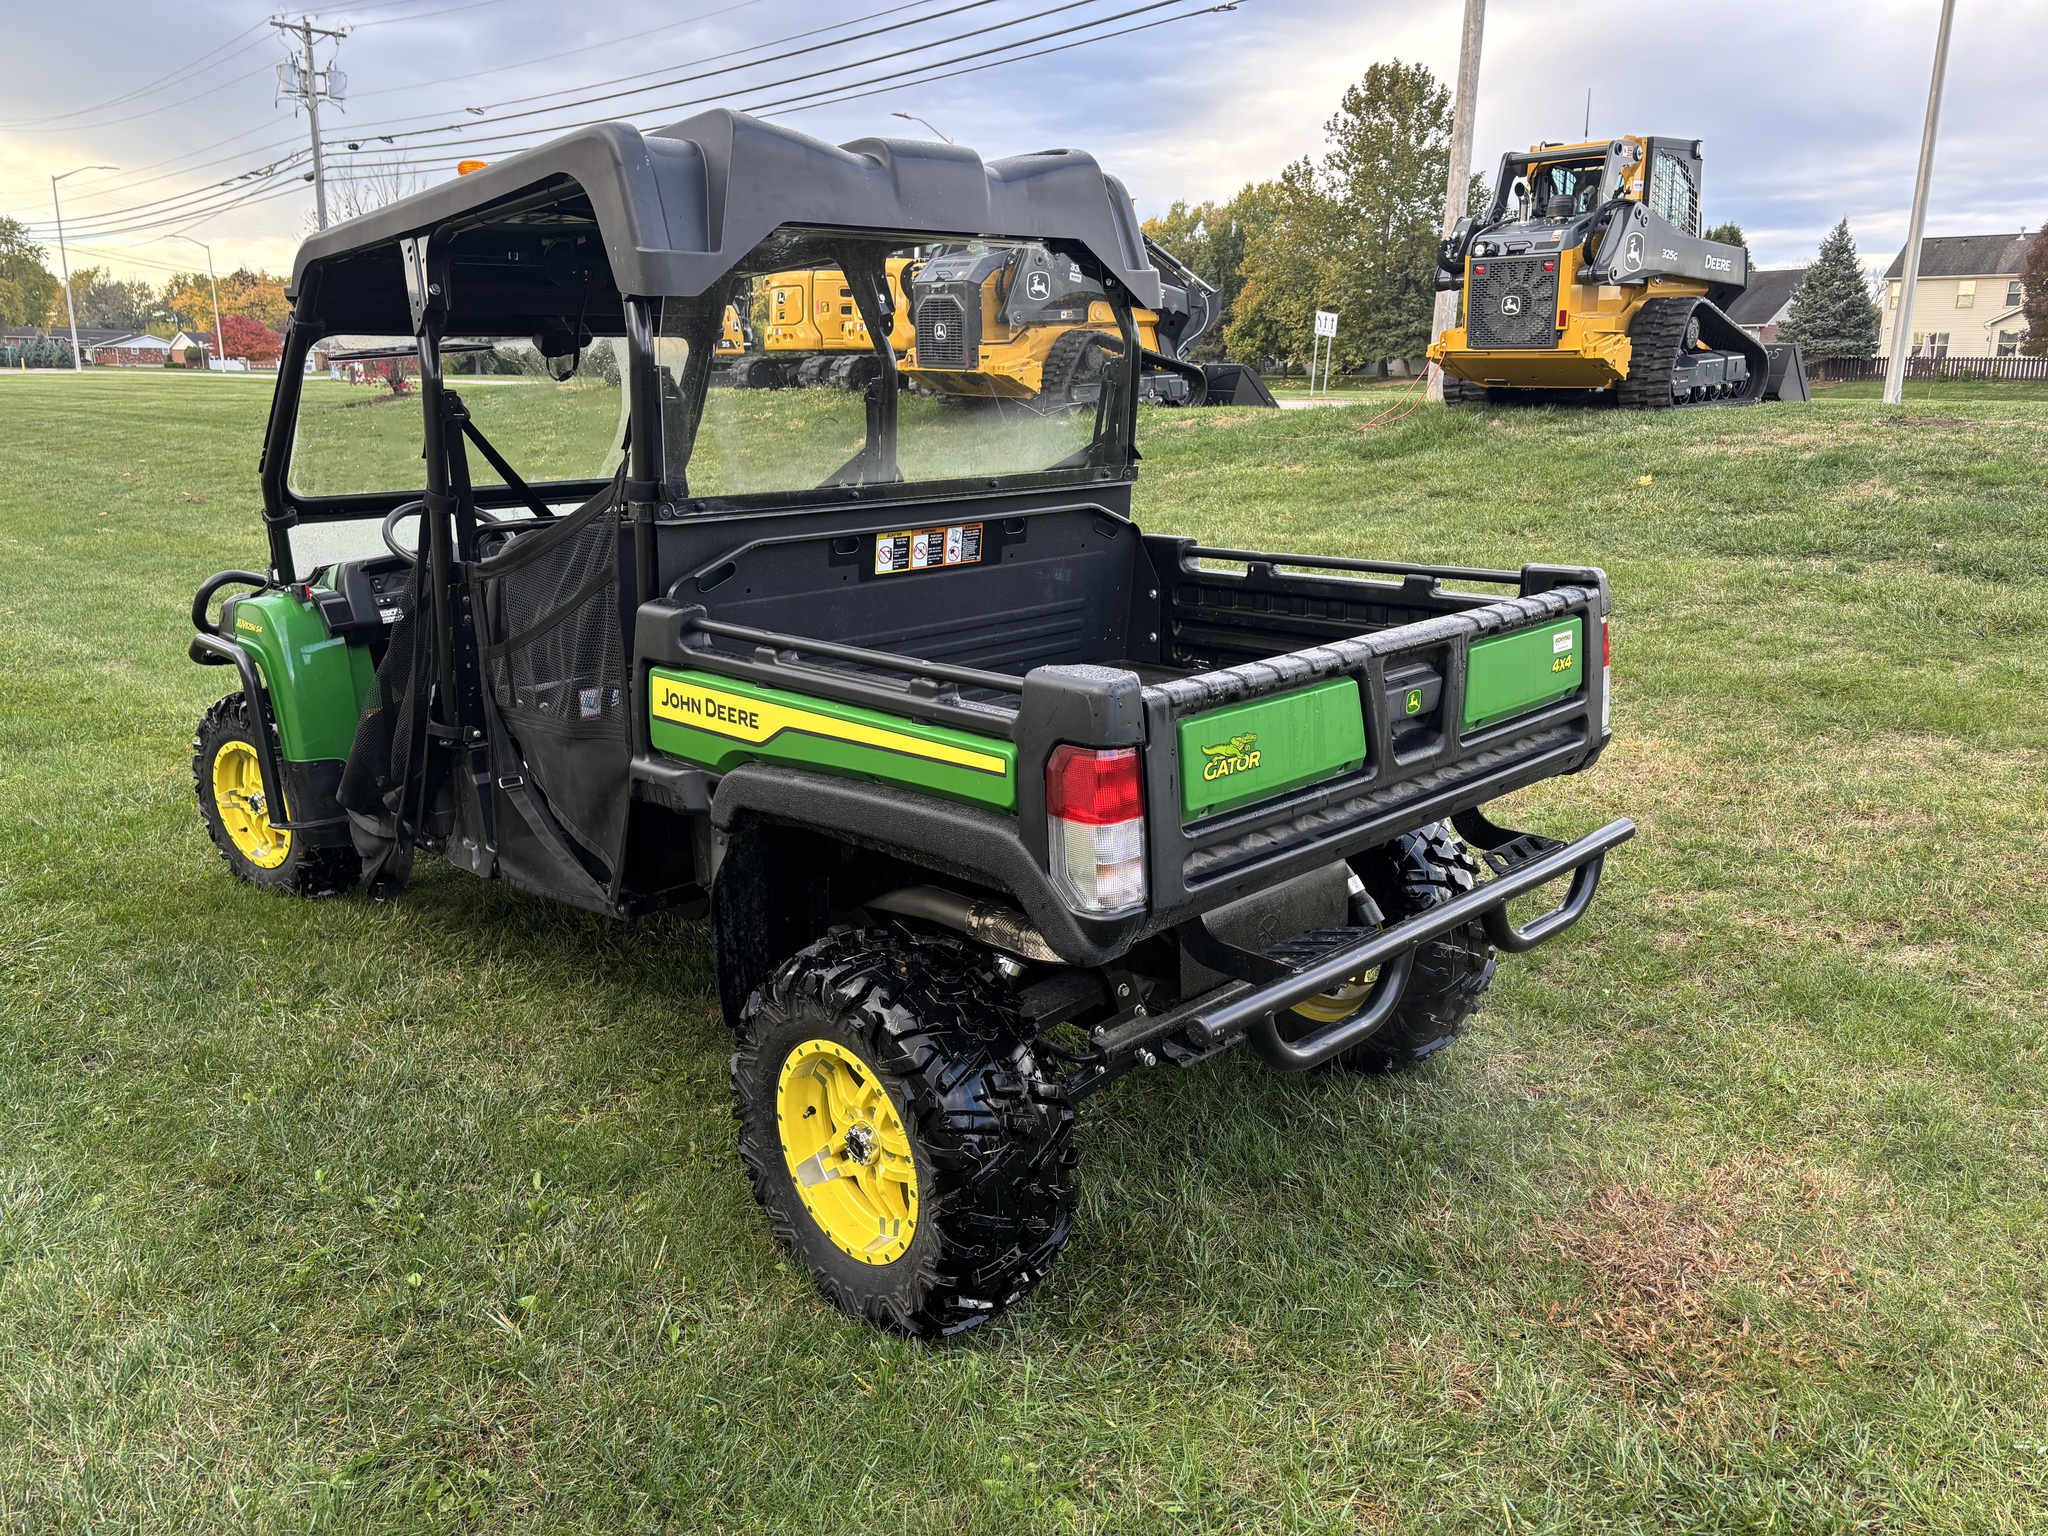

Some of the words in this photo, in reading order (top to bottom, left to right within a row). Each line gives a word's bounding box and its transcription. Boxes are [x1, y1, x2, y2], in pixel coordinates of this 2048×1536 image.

[1661, 248, 1678, 261] 325G
[1704, 253, 1732, 272] DEERE
[1069, 262, 1082, 274] 33
[661, 688, 702, 716] JOHN
[705, 697, 760, 730] DEERE
[1203, 750, 1262, 782] GATOR
